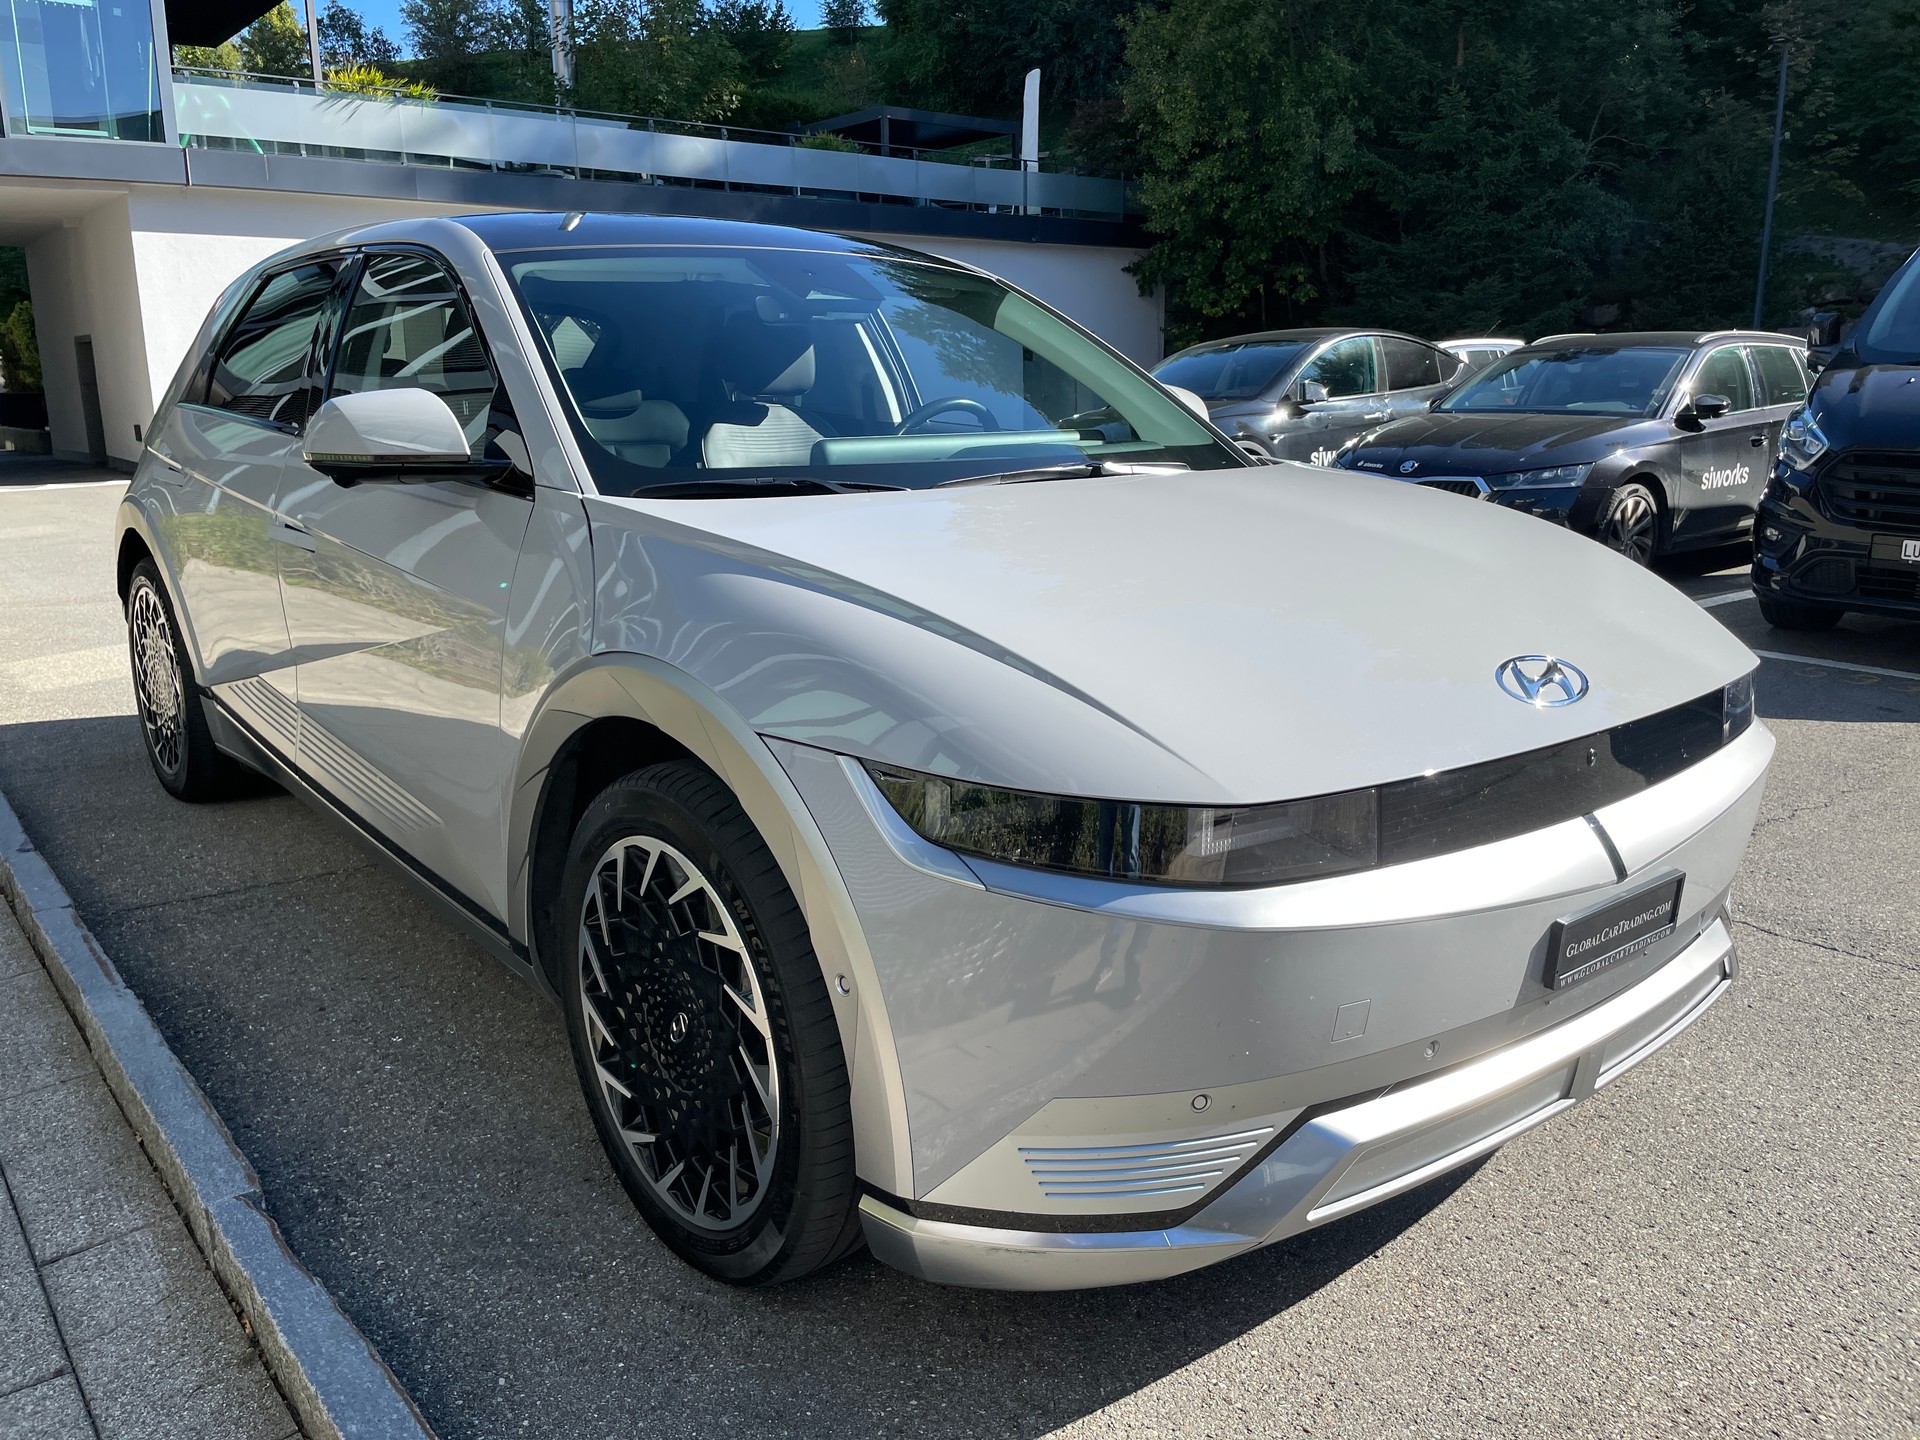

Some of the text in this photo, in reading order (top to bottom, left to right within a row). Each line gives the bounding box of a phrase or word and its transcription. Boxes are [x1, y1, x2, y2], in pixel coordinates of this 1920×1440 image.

[1701, 462, 1749, 490] siworks
[1560, 927, 1671, 987] WWW.GLOBALCARTRADING.COM
[1565, 900, 1671, 958] GLOBALCARTRADING.COM
[733, 897, 793, 1054] MICHELIN
